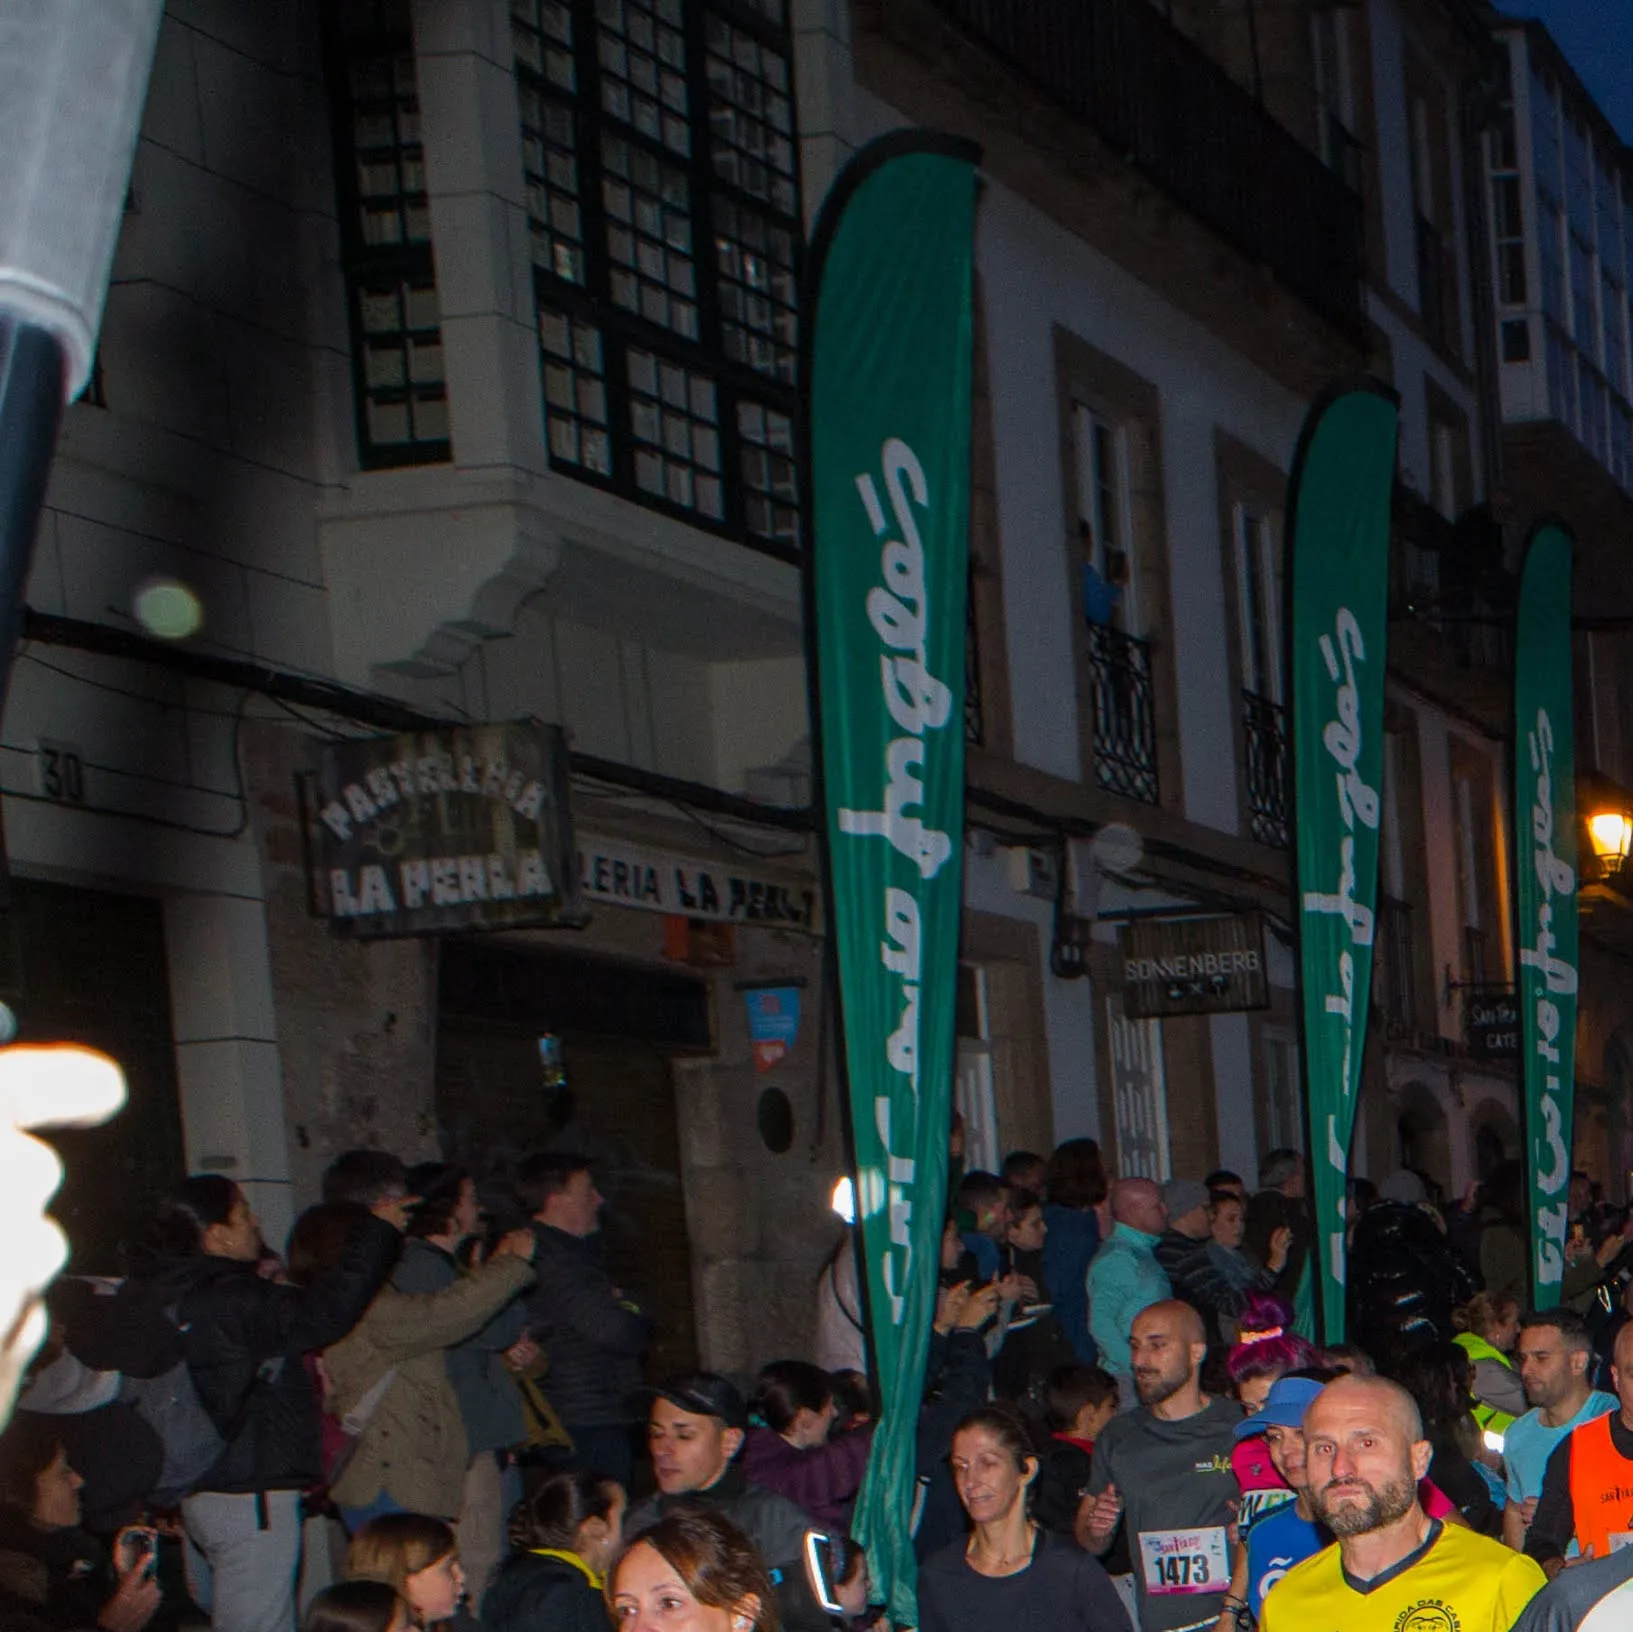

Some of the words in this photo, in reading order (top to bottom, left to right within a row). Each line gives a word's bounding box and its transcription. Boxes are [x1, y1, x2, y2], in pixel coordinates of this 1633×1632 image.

[838, 438, 953, 879] Inglés
[41, 749, 83, 800] 30
[1303, 604, 1380, 945] Inglés
[330, 863, 397, 918] LA
[399, 848, 555, 909] PERLA
[675, 866, 721, 909] LA
[1154, 1554, 1210, 1587] 1473
